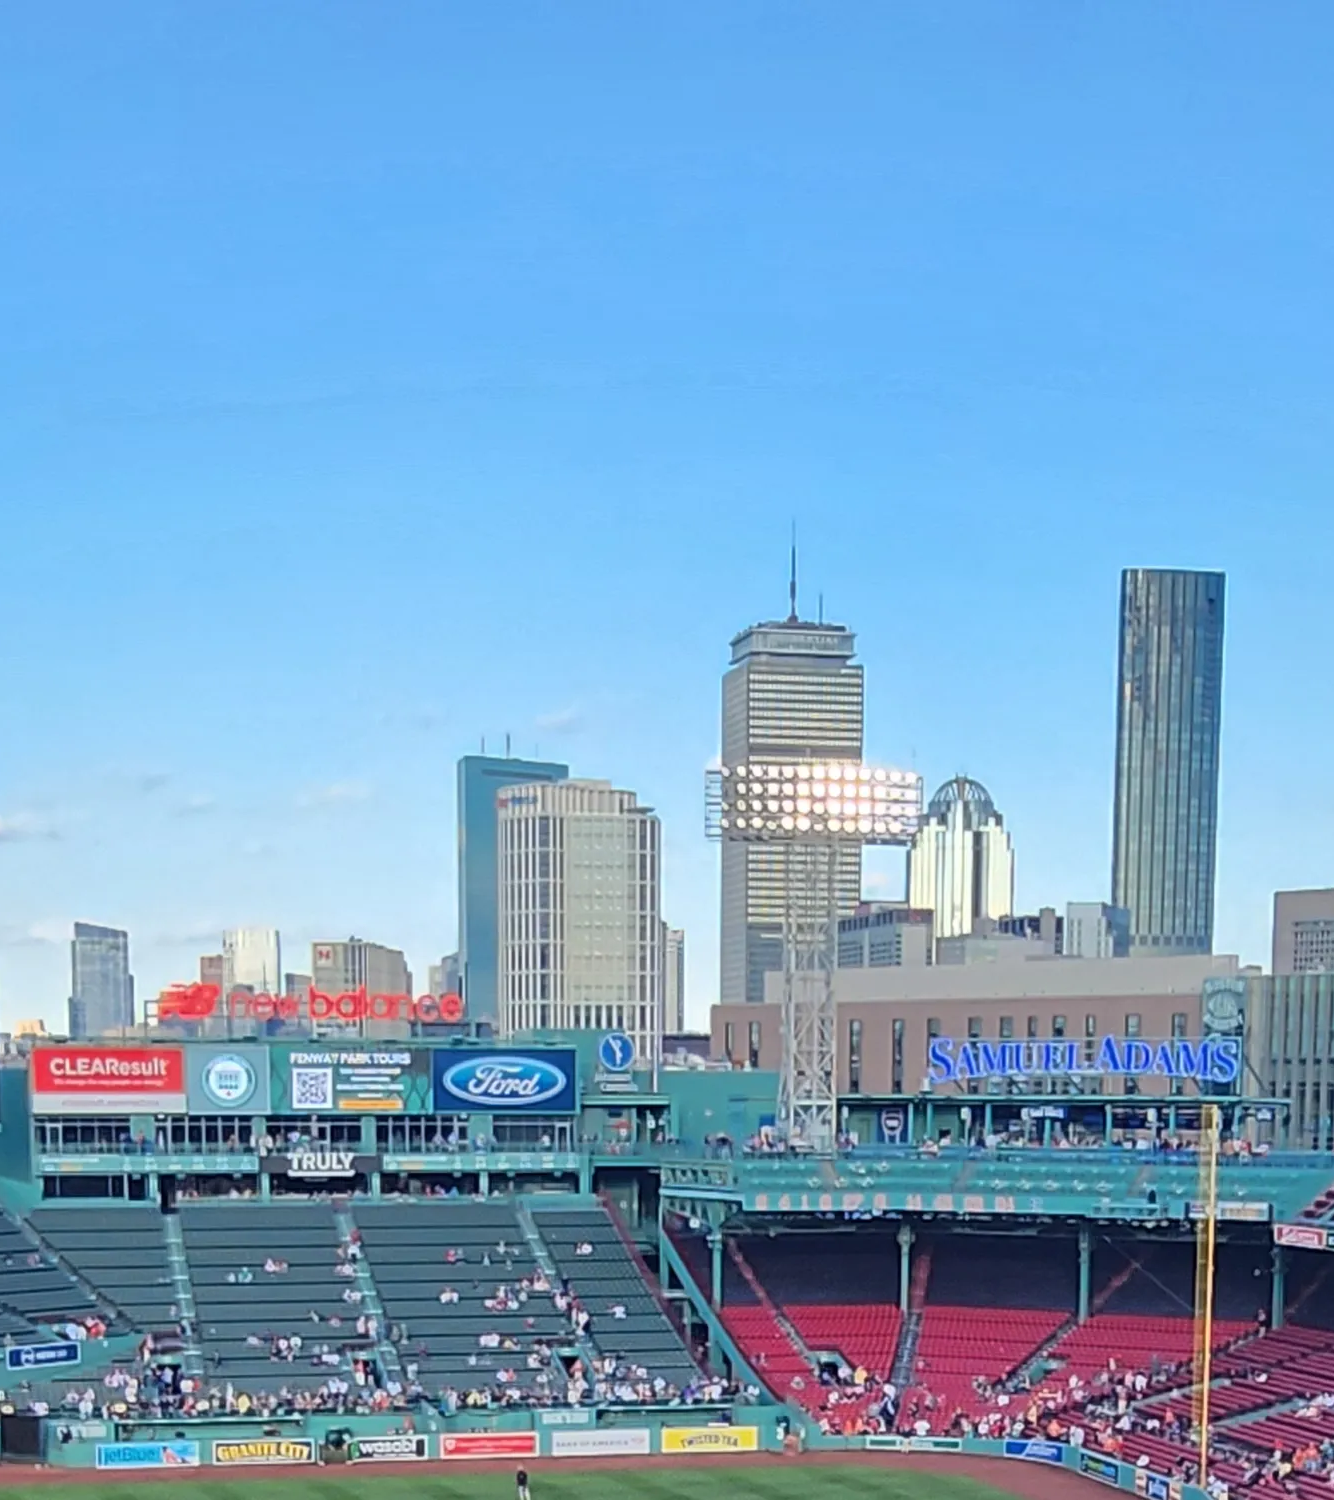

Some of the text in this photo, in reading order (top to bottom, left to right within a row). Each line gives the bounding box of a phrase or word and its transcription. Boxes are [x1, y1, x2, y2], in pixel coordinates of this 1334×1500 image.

[230, 982, 465, 1022] new balance
[49, 1057, 168, 1076] CLEAResult
[289, 1052, 412, 1065] FENWAY PARK TOURS
[928, 1034, 1239, 1084] SAMUEL ADAMS
[468, 1063, 542, 1096] Ford
[286, 1152, 356, 1171] TRULY
[216, 1442, 310, 1462] GRANITE CITY
[359, 1438, 416, 1455] wasabi
[679, 1436, 739, 1449] TWISTED TEA
[104, 1445, 159, 1466] jetBlue
